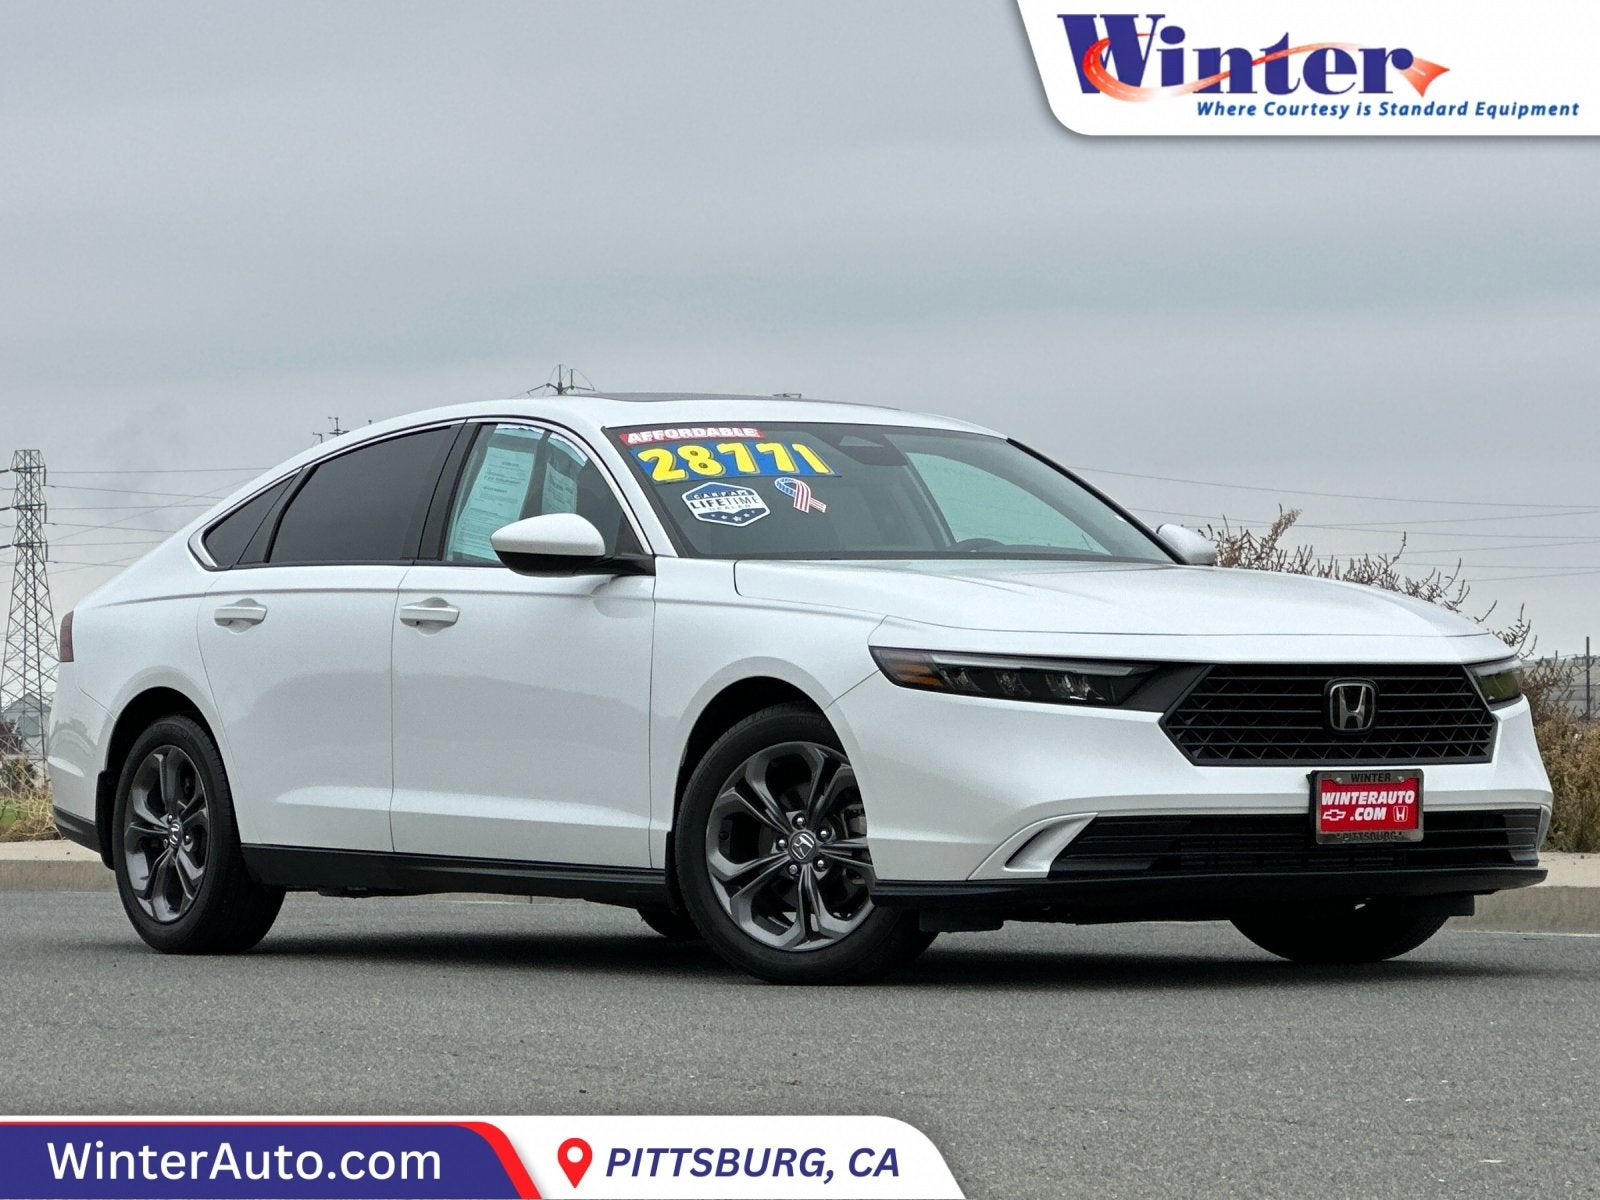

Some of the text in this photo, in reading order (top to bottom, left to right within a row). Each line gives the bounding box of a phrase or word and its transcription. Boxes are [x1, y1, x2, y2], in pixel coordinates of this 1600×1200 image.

[627, 428, 761, 444] AFFORDABLE
[637, 442, 831, 482] 28771
[1351, 772, 1391, 783] WINTER
[1321, 790, 1415, 806] WINTERAUTO
[1349, 807, 1387, 821] .COM
